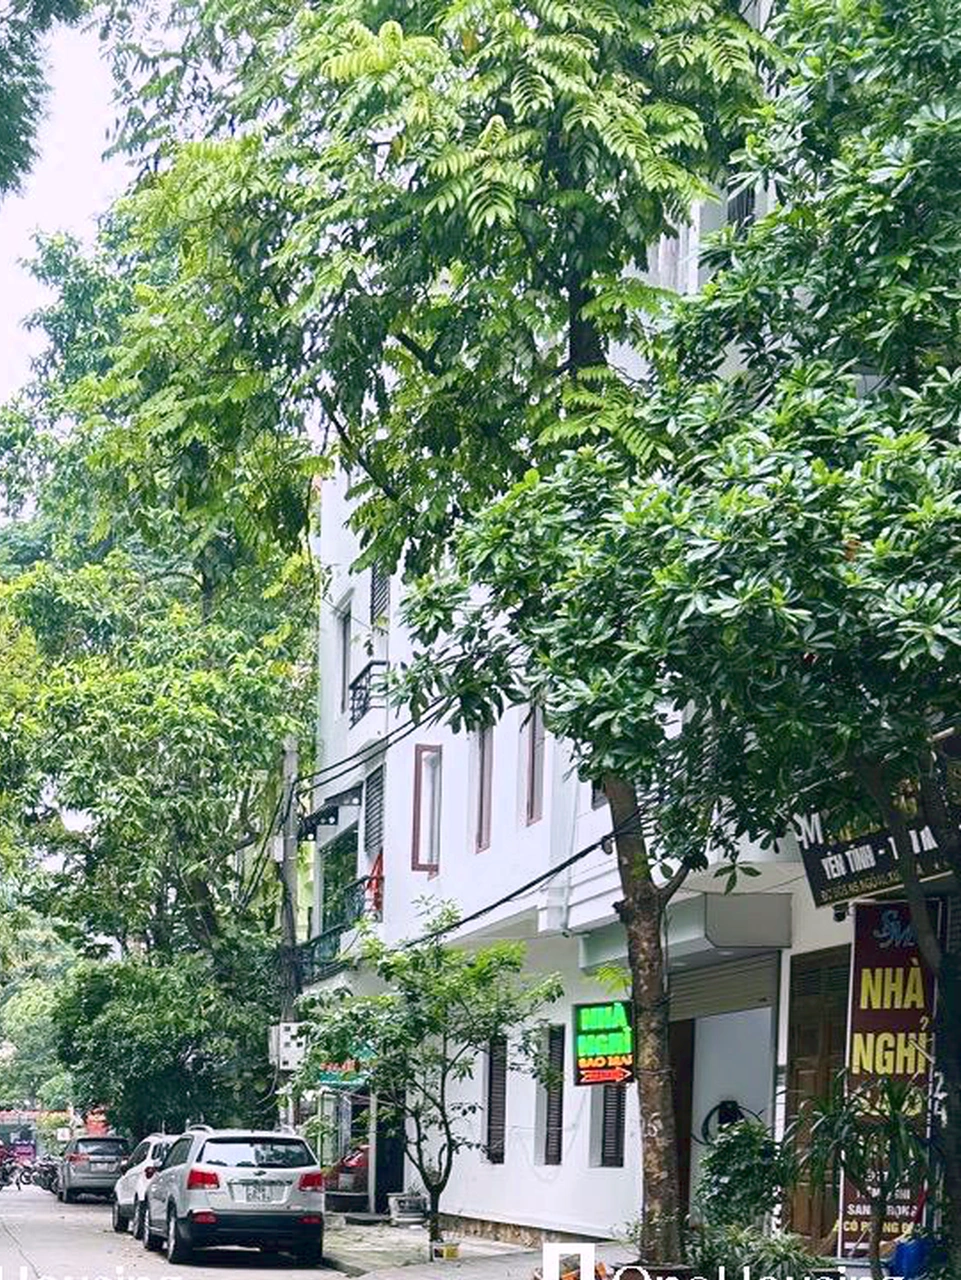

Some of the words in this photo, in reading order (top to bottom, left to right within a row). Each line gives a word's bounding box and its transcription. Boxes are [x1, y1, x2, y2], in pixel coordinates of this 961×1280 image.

[860, 957, 925, 1009] NHÀ
[580, 1002, 627, 1030] NHÀ
[852, 1016, 928, 1075] NGHỈ
[861, 1221, 899, 1233] PNG
